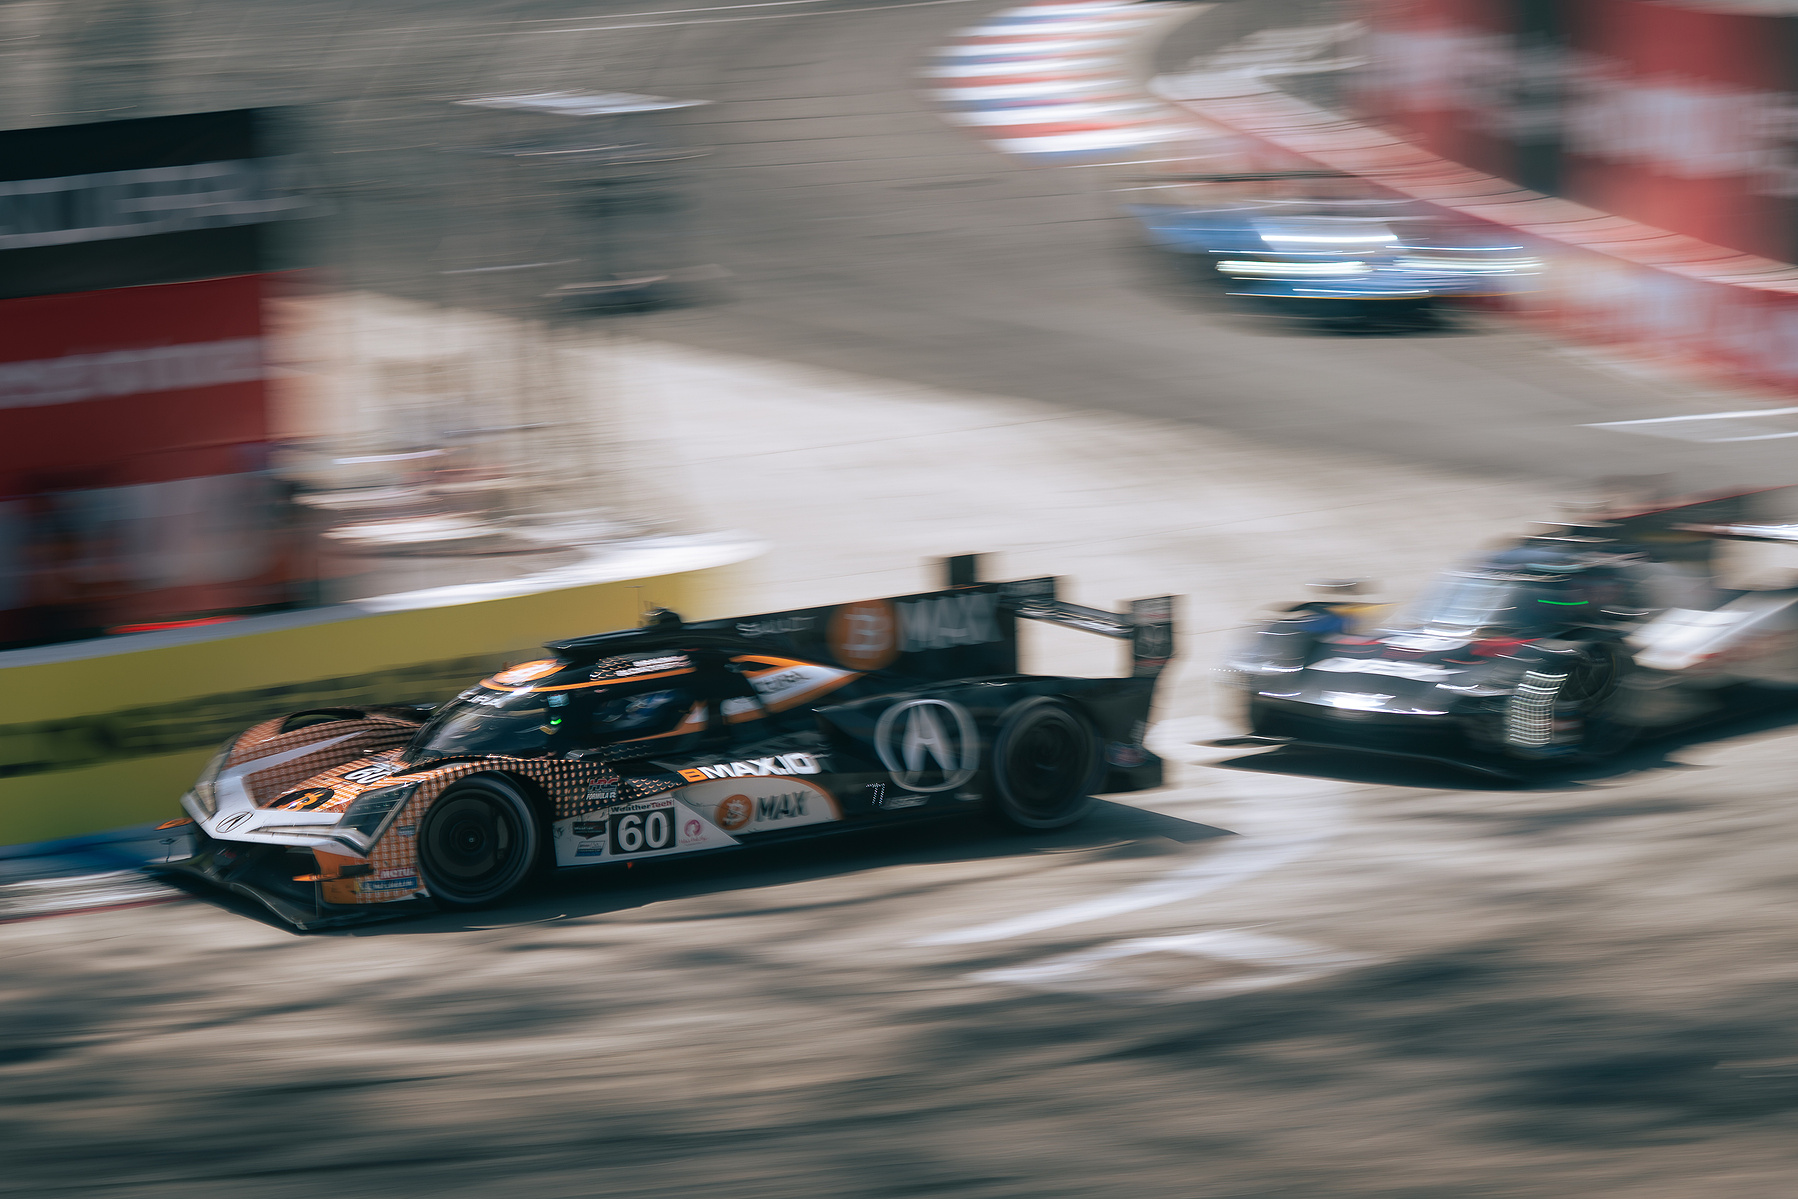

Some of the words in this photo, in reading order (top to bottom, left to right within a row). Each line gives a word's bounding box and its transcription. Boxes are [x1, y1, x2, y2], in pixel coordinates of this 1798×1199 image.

[611, 800, 672, 812] WeatherTech
[755, 790, 810, 822] MAX
[617, 811, 669, 851] 60
[381, 867, 417, 879] MOTUL
